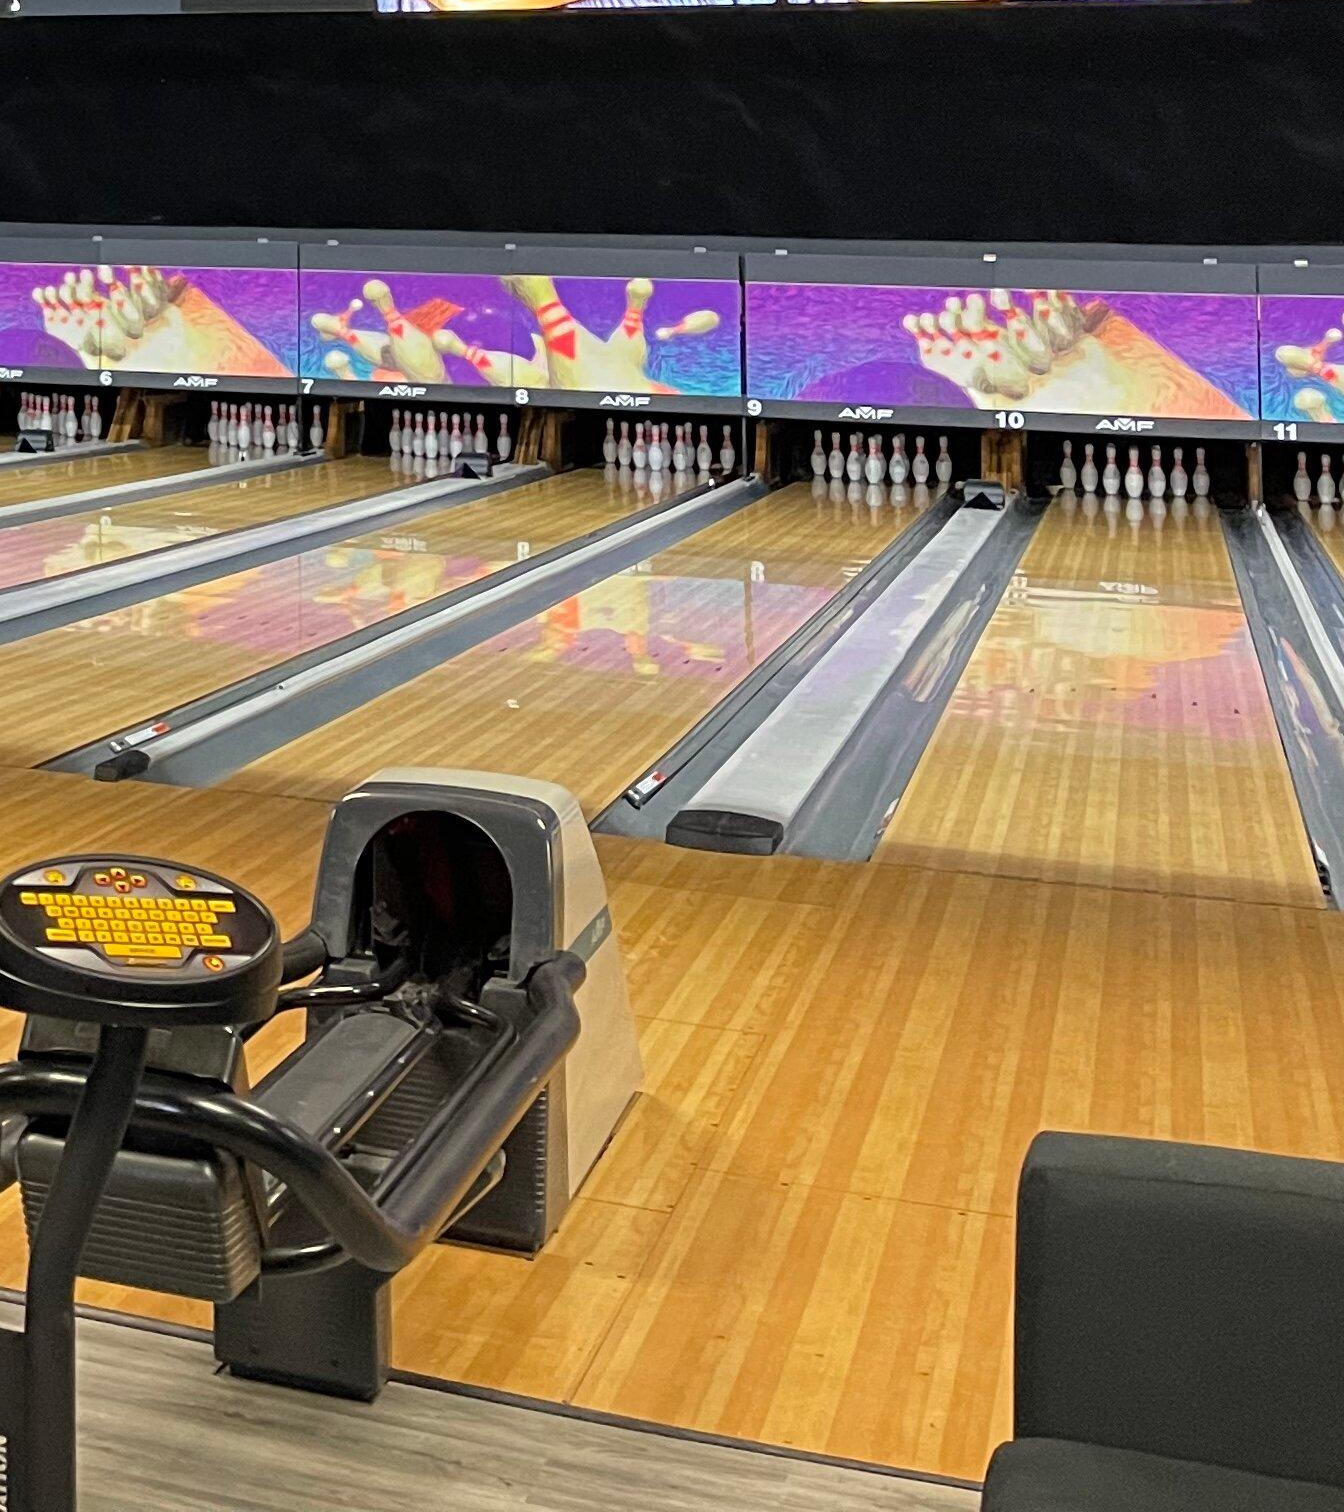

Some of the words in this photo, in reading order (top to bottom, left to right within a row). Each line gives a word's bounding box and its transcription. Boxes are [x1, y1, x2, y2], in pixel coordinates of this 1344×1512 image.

[99, 371, 113, 386] 6
[173, 376, 218, 387] AMF
[301, 379, 314, 394] 7
[378, 384, 427, 397] AMF
[515, 388, 530, 405] 8
[599, 394, 651, 407] AMF
[747, 399, 762, 416] 9
[838, 406, 894, 420] AMF
[995, 411, 1025, 429] 10
[1095, 417, 1155, 432] AMF
[1273, 423, 1297, 441] 11
